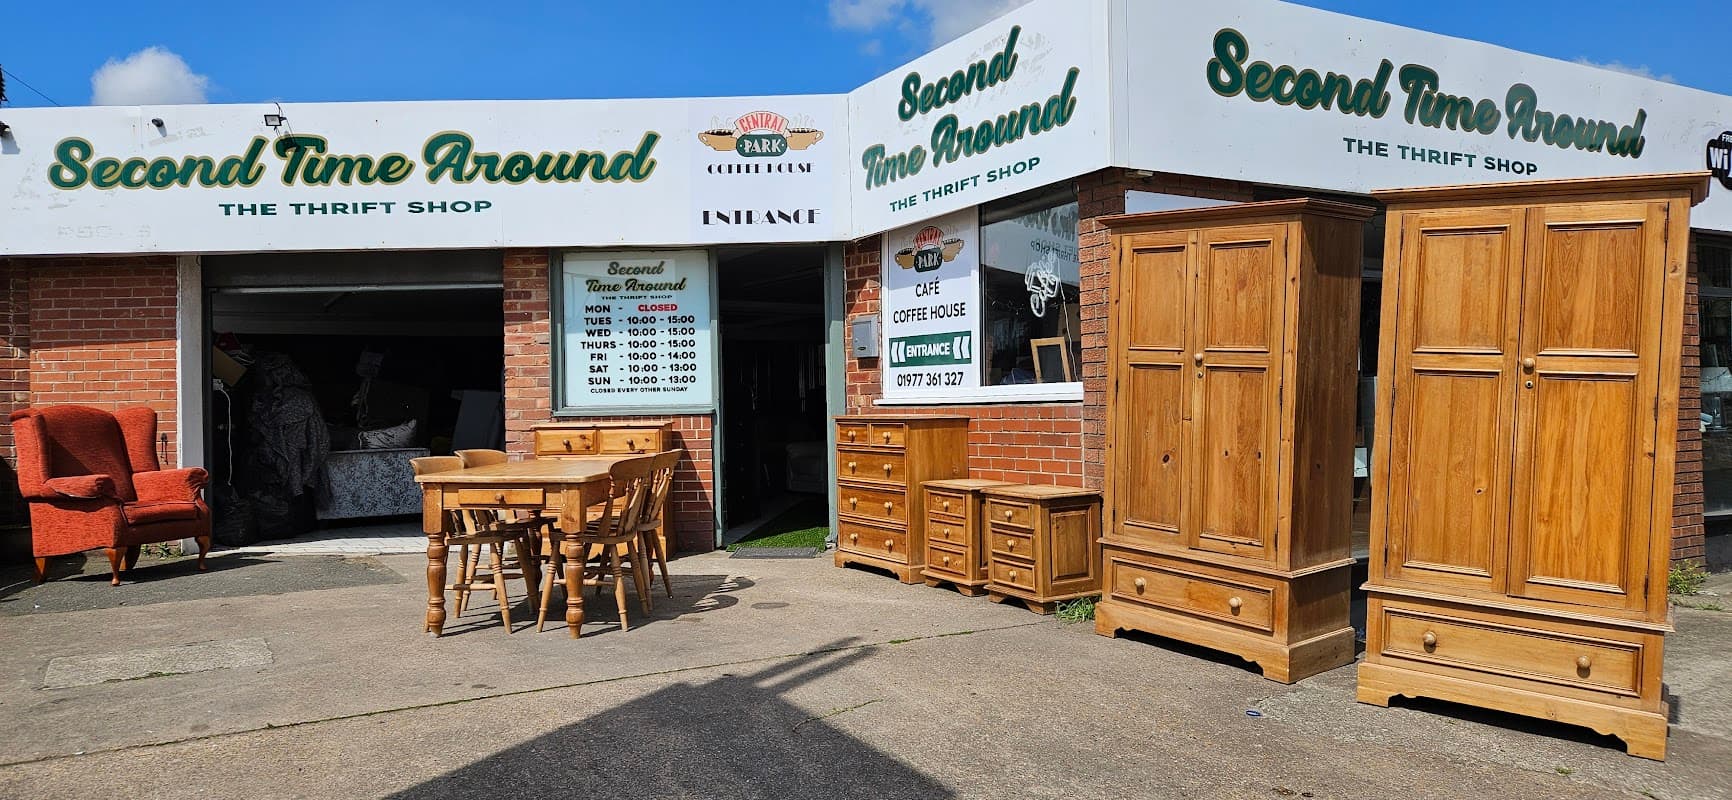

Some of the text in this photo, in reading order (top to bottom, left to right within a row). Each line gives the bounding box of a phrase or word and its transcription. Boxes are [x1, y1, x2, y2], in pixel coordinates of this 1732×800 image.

[898, 24, 1021, 121] Second
[1207, 28, 1647, 159] Second Time Around
[739, 112, 785, 133] CENTRAL
[862, 65, 1080, 192] Time Around
[743, 138, 781, 153] PARK
[48, 131, 661, 190] Second Time Around
[1343, 138, 1537, 175] THE THRIFT SHOP
[707, 162, 816, 175] COFFEE HOUSE
[890, 157, 1040, 212] THE THRIFT SHOP
[219, 201, 491, 216] THE THRIFT SHOP
[702, 208, 821, 226] ENTRANCE
[608, 260, 666, 276] Second
[916, 252, 941, 269] PARK
[586, 277, 687, 293] Time Around
[916, 276, 939, 297] CAFÉ
[585, 305, 611, 314] MON
[638, 304, 678, 312] CLOSED
[894, 302, 965, 323] COFFEE HOUSE
[584, 317, 612, 326] TUES
[627, 316, 657, 325] 10:00
[668, 315, 695, 324] 15:00
[585, 329, 612, 338] WED
[628, 328, 657, 337] 10:00
[668, 327, 696, 336] 15:00
[580, 341, 617, 350] THURS
[628, 340, 657, 349] 10:00
[668, 340, 696, 348] 15:00
[907, 343, 950, 357] ENTRANCE
[591, 353, 607, 362] FRI
[628, 352, 657, 361] 10:00
[668, 352, 696, 360] 14:00
[589, 365, 609, 374] SAT
[628, 364, 659, 373] 10:00
[670, 364, 697, 372] 13:00
[588, 377, 611, 386] SUN
[629, 376, 658, 385] 10:00
[669, 375, 697, 384] 13:00
[897, 372, 963, 386] 01977 361 327
